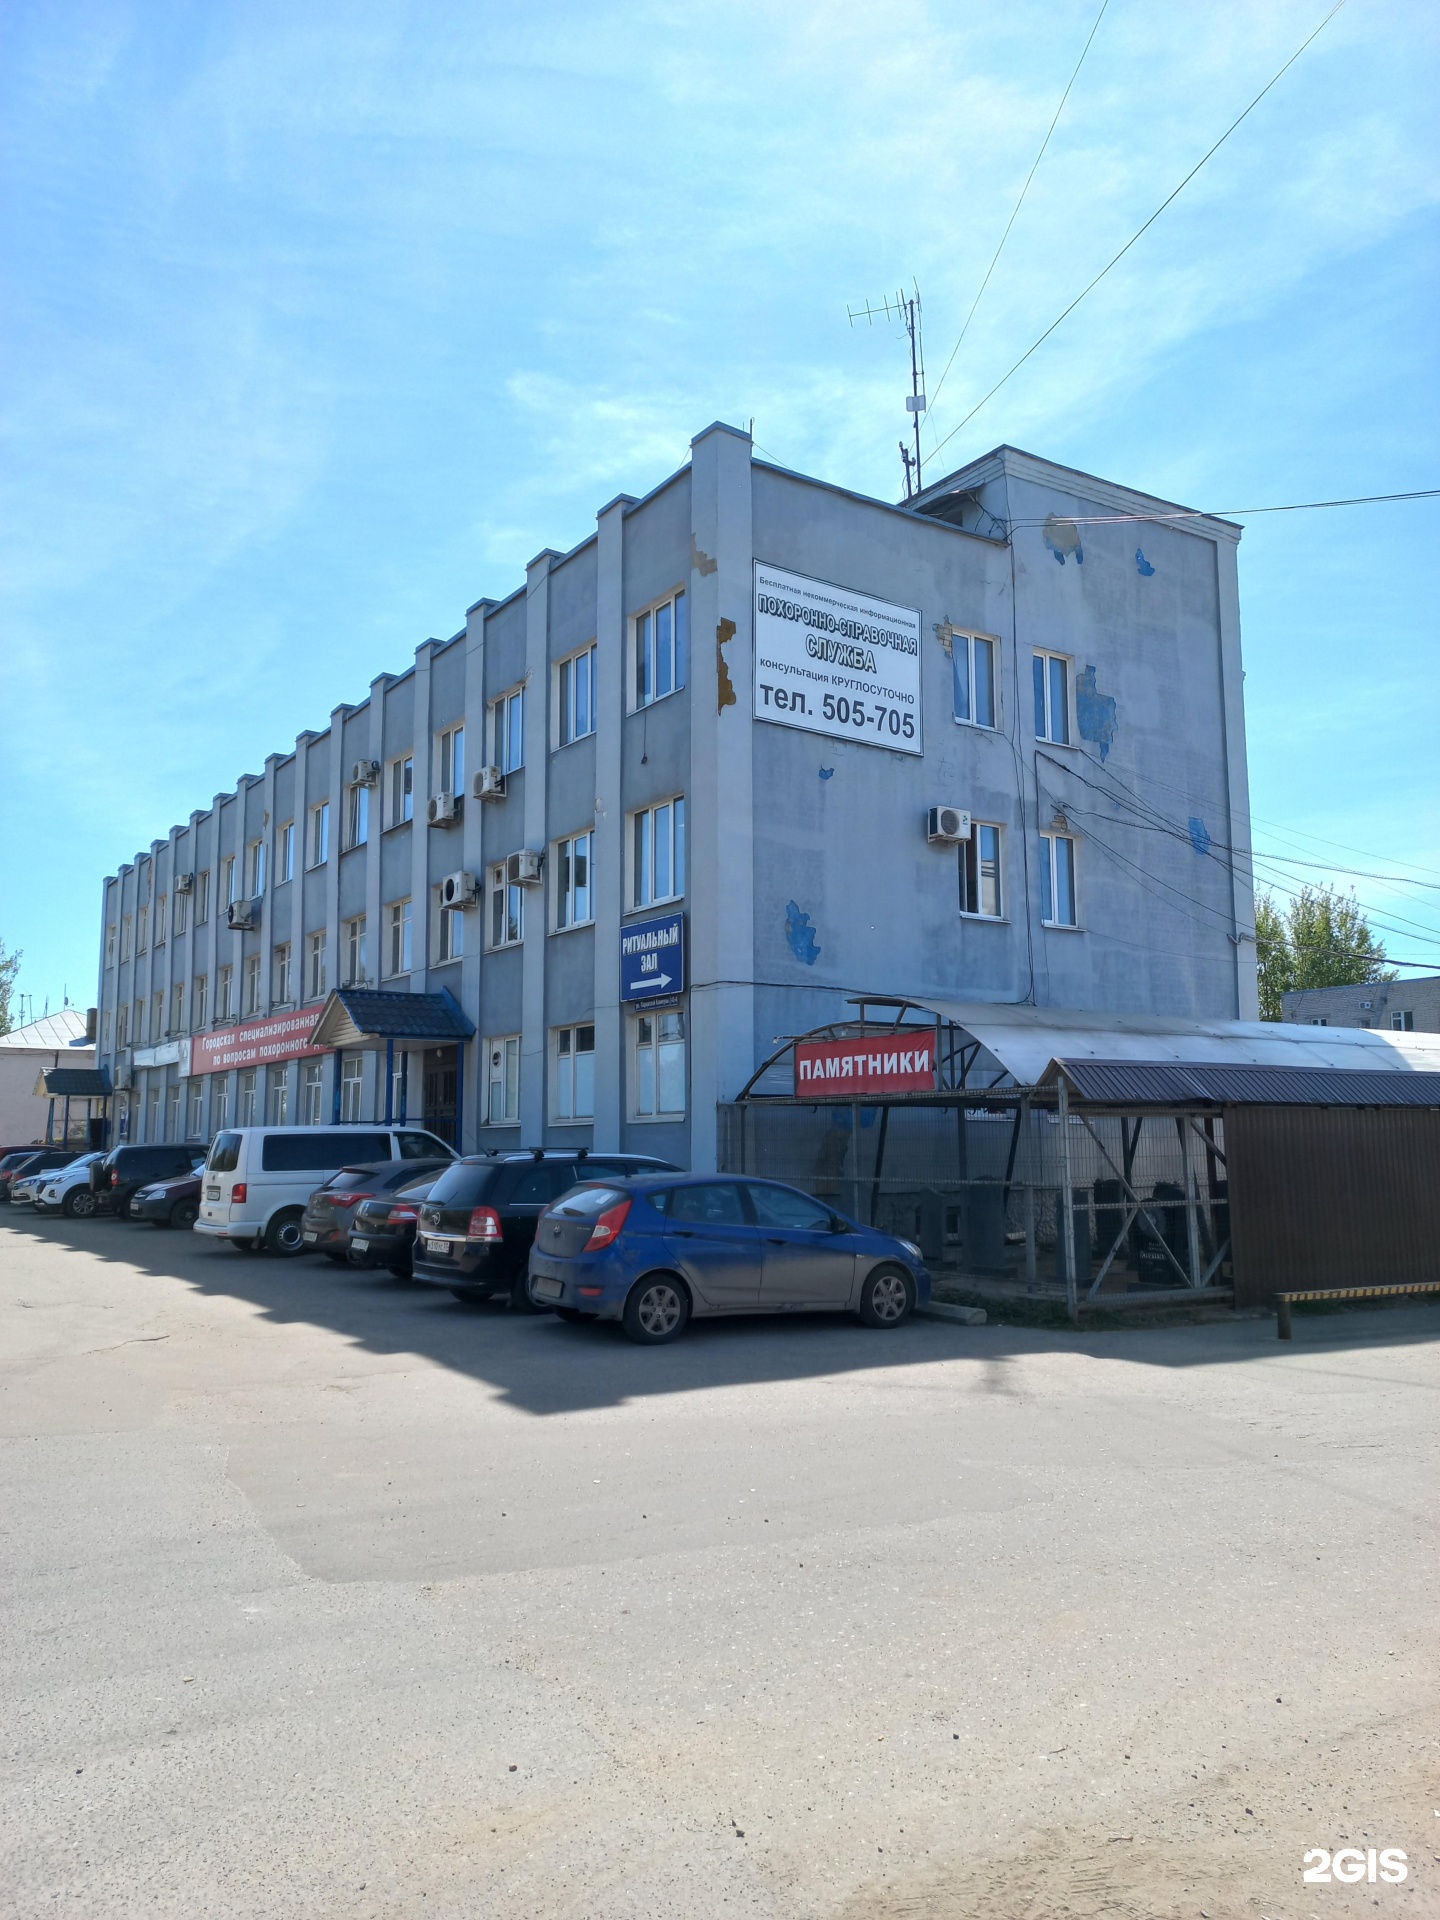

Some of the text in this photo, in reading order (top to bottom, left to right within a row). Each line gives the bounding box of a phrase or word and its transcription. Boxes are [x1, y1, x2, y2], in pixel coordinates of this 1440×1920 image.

[759, 576, 916, 629] Бесплатная некоммерческая информационная
[758, 593, 918, 656] ПОХОРОННО-СПРАВОЧНАЯ
[805, 633, 878, 674] СЛУЖБА
[760, 657, 915, 705] консультация КРУГЛОСУТОЧНО
[760, 683, 915, 739] тел. 505-705
[622, 923, 679, 955] РИТУАЛЬНЫЙ
[640, 952, 658, 973] ЗАЛ
[201, 1012, 320, 1052] Городская специализированная
[212, 1054, 221, 1067] по
[223, 1048, 256, 1066] вопросам
[800, 1049, 929, 1080] ПАМЯТНИКИ
